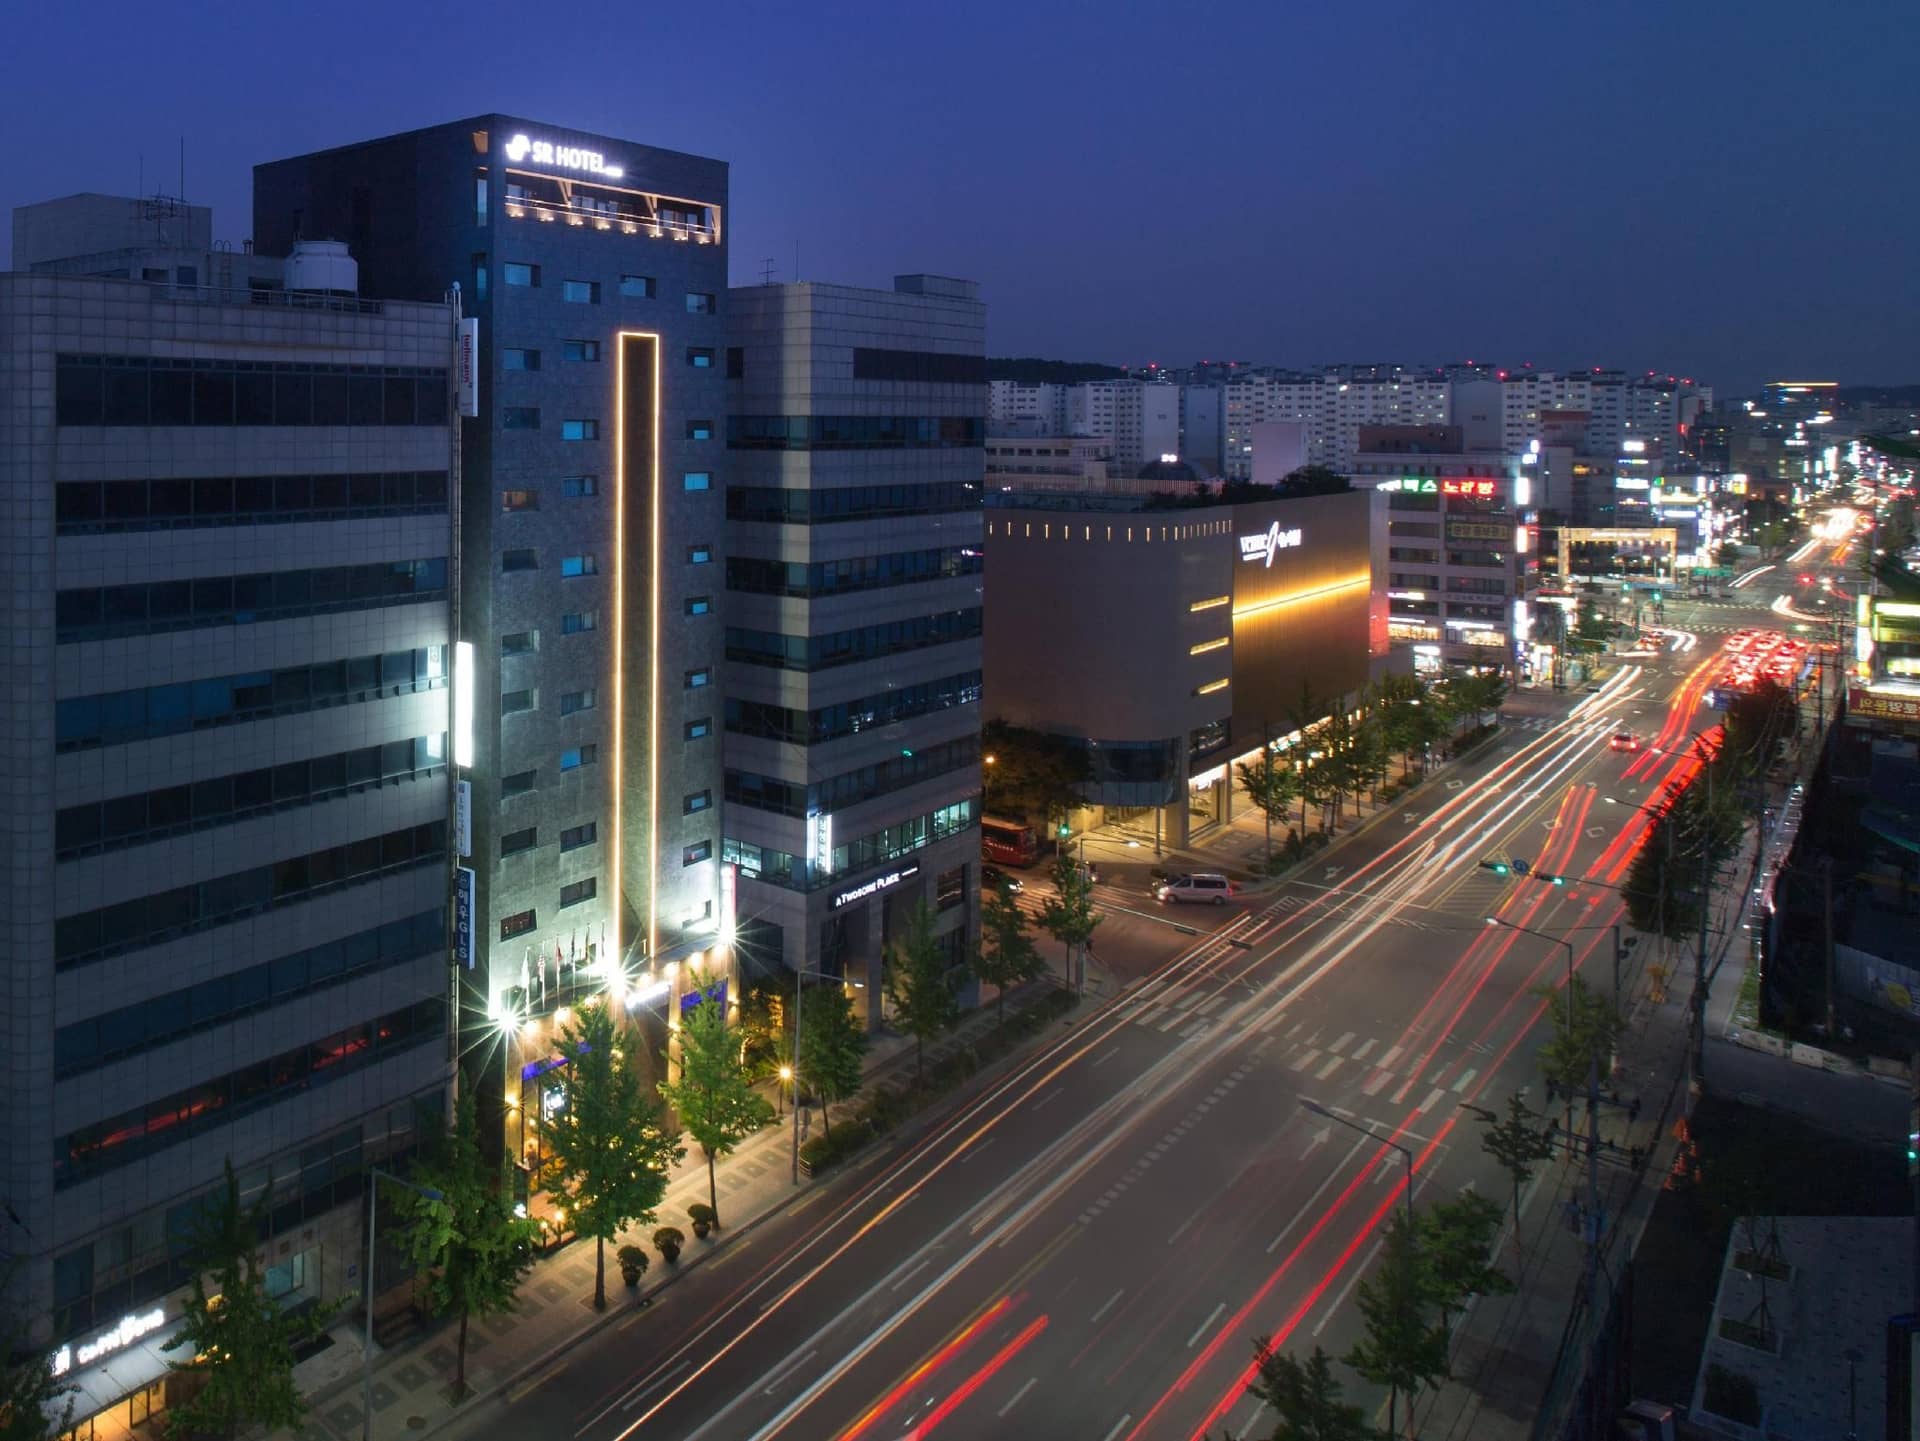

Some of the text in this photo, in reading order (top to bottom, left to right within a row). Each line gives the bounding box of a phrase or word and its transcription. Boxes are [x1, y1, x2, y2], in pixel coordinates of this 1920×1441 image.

[532, 141, 554, 164] SR
[556, 145, 606, 173] HOTEL
[841, 881, 877, 903] TWOSOME
[876, 872, 900, 889] PLACE
